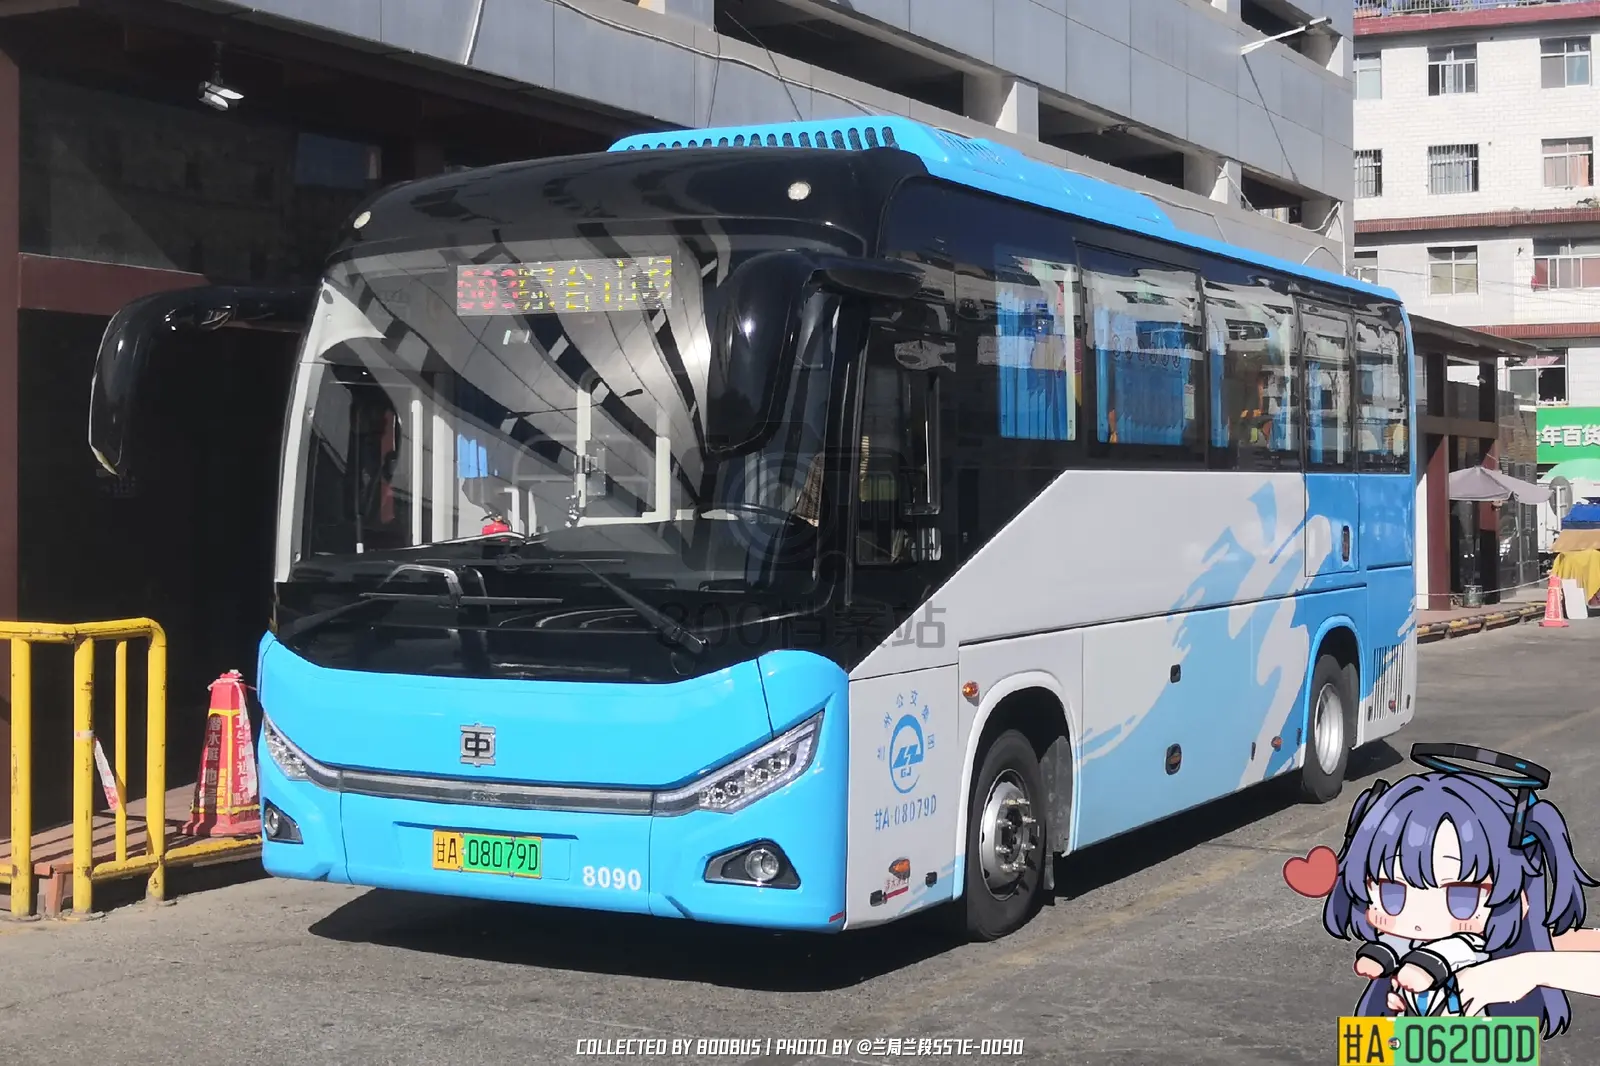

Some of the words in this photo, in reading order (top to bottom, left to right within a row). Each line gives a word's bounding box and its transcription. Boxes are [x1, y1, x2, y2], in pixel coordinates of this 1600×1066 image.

[1536, 424, 1600, 447] 年百货
[582, 866, 642, 891] 8090
